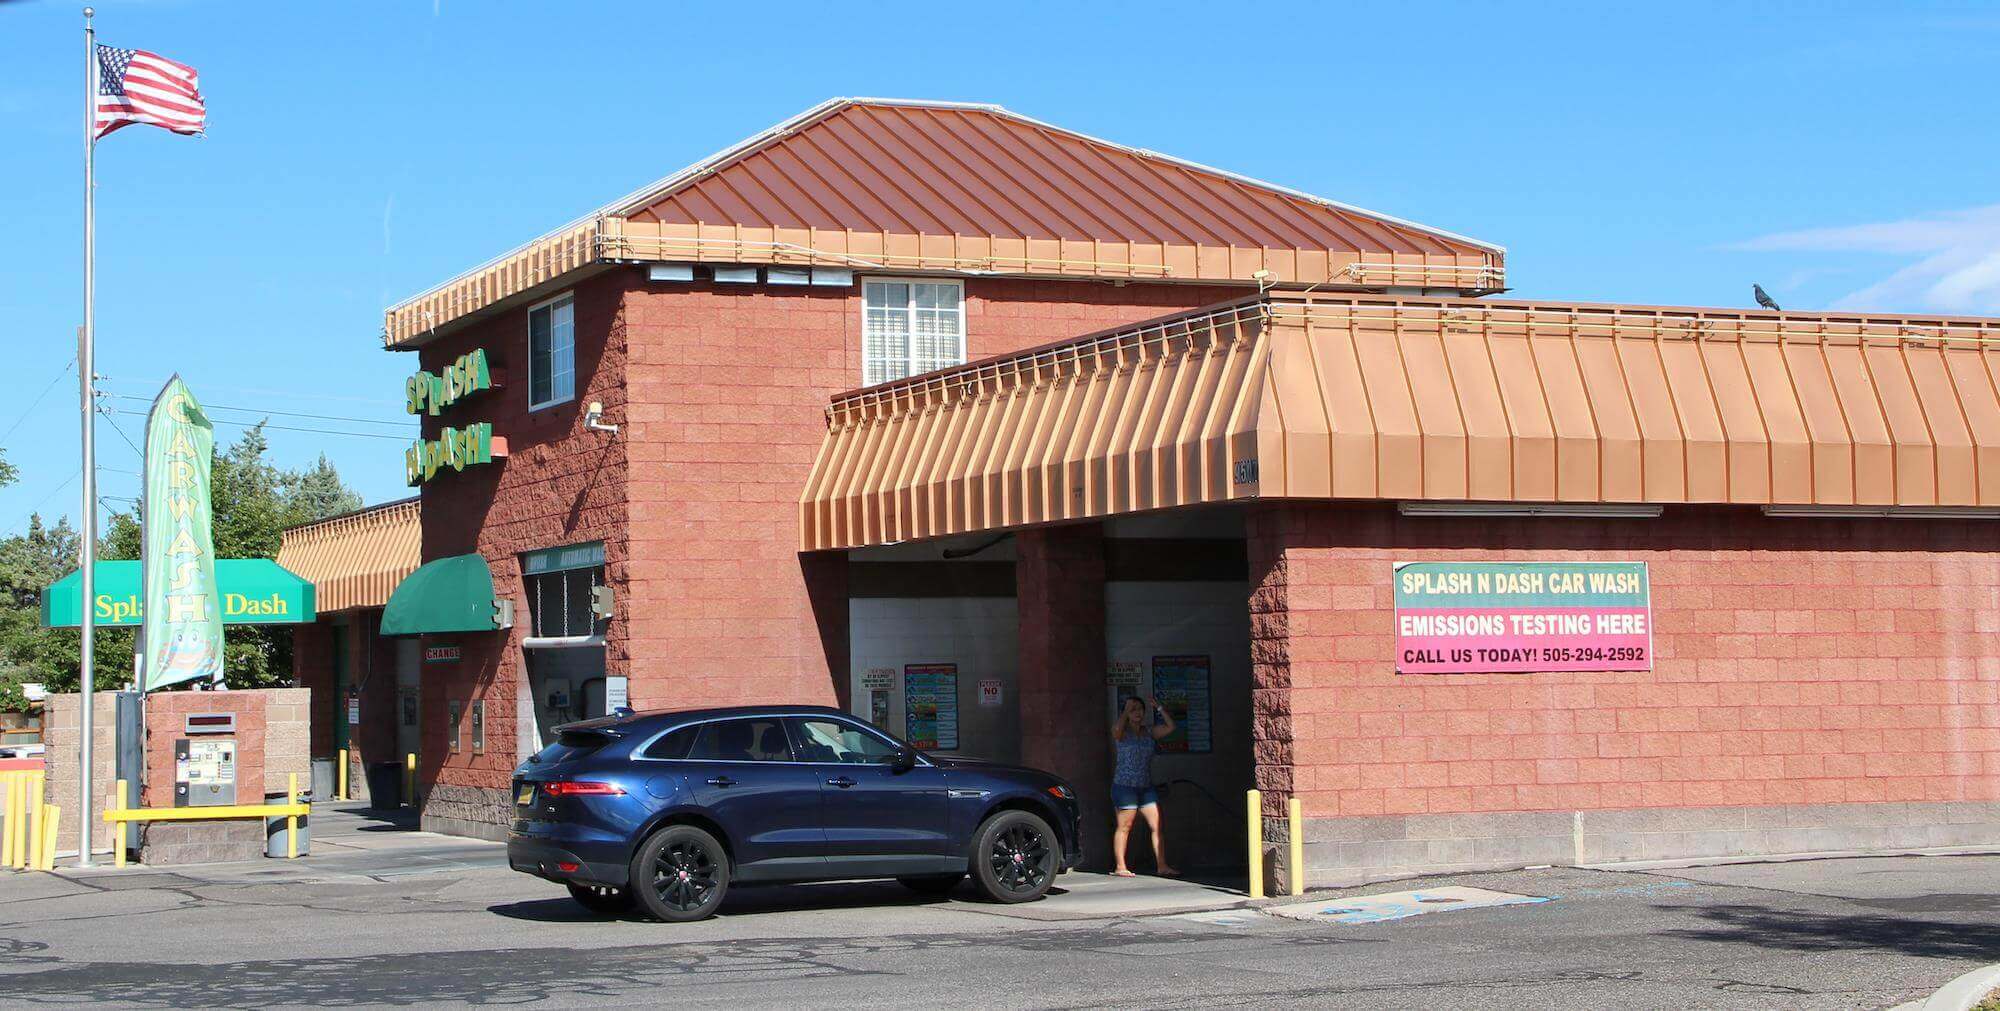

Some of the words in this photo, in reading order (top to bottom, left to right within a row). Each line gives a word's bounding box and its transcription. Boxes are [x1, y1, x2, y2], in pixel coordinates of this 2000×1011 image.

[406, 348, 487, 416] SPLASH
[425, 422, 491, 482] DASH
[1402, 573, 1472, 595] SPLASH
[1477, 573, 1491, 594] N
[1495, 573, 1544, 594] DASH
[1548, 573, 1586, 594] CAR
[1589, 573, 1640, 594] WASH
[95, 593, 143, 624] Spl
[223, 592, 288, 617] Dash
[1400, 614, 1505, 637] EMISSIONS
[1509, 614, 1592, 636] TESTING
[1596, 614, 1646, 635] HERE
[427, 648, 460, 659] CHANGE
[1404, 649, 1446, 664] CALL
[1450, 649, 1473, 664] US
[1477, 648, 1537, 663] TODAY!
[1542, 647, 1644, 662] 505-294-2592
[984, 687, 998, 695] NO
